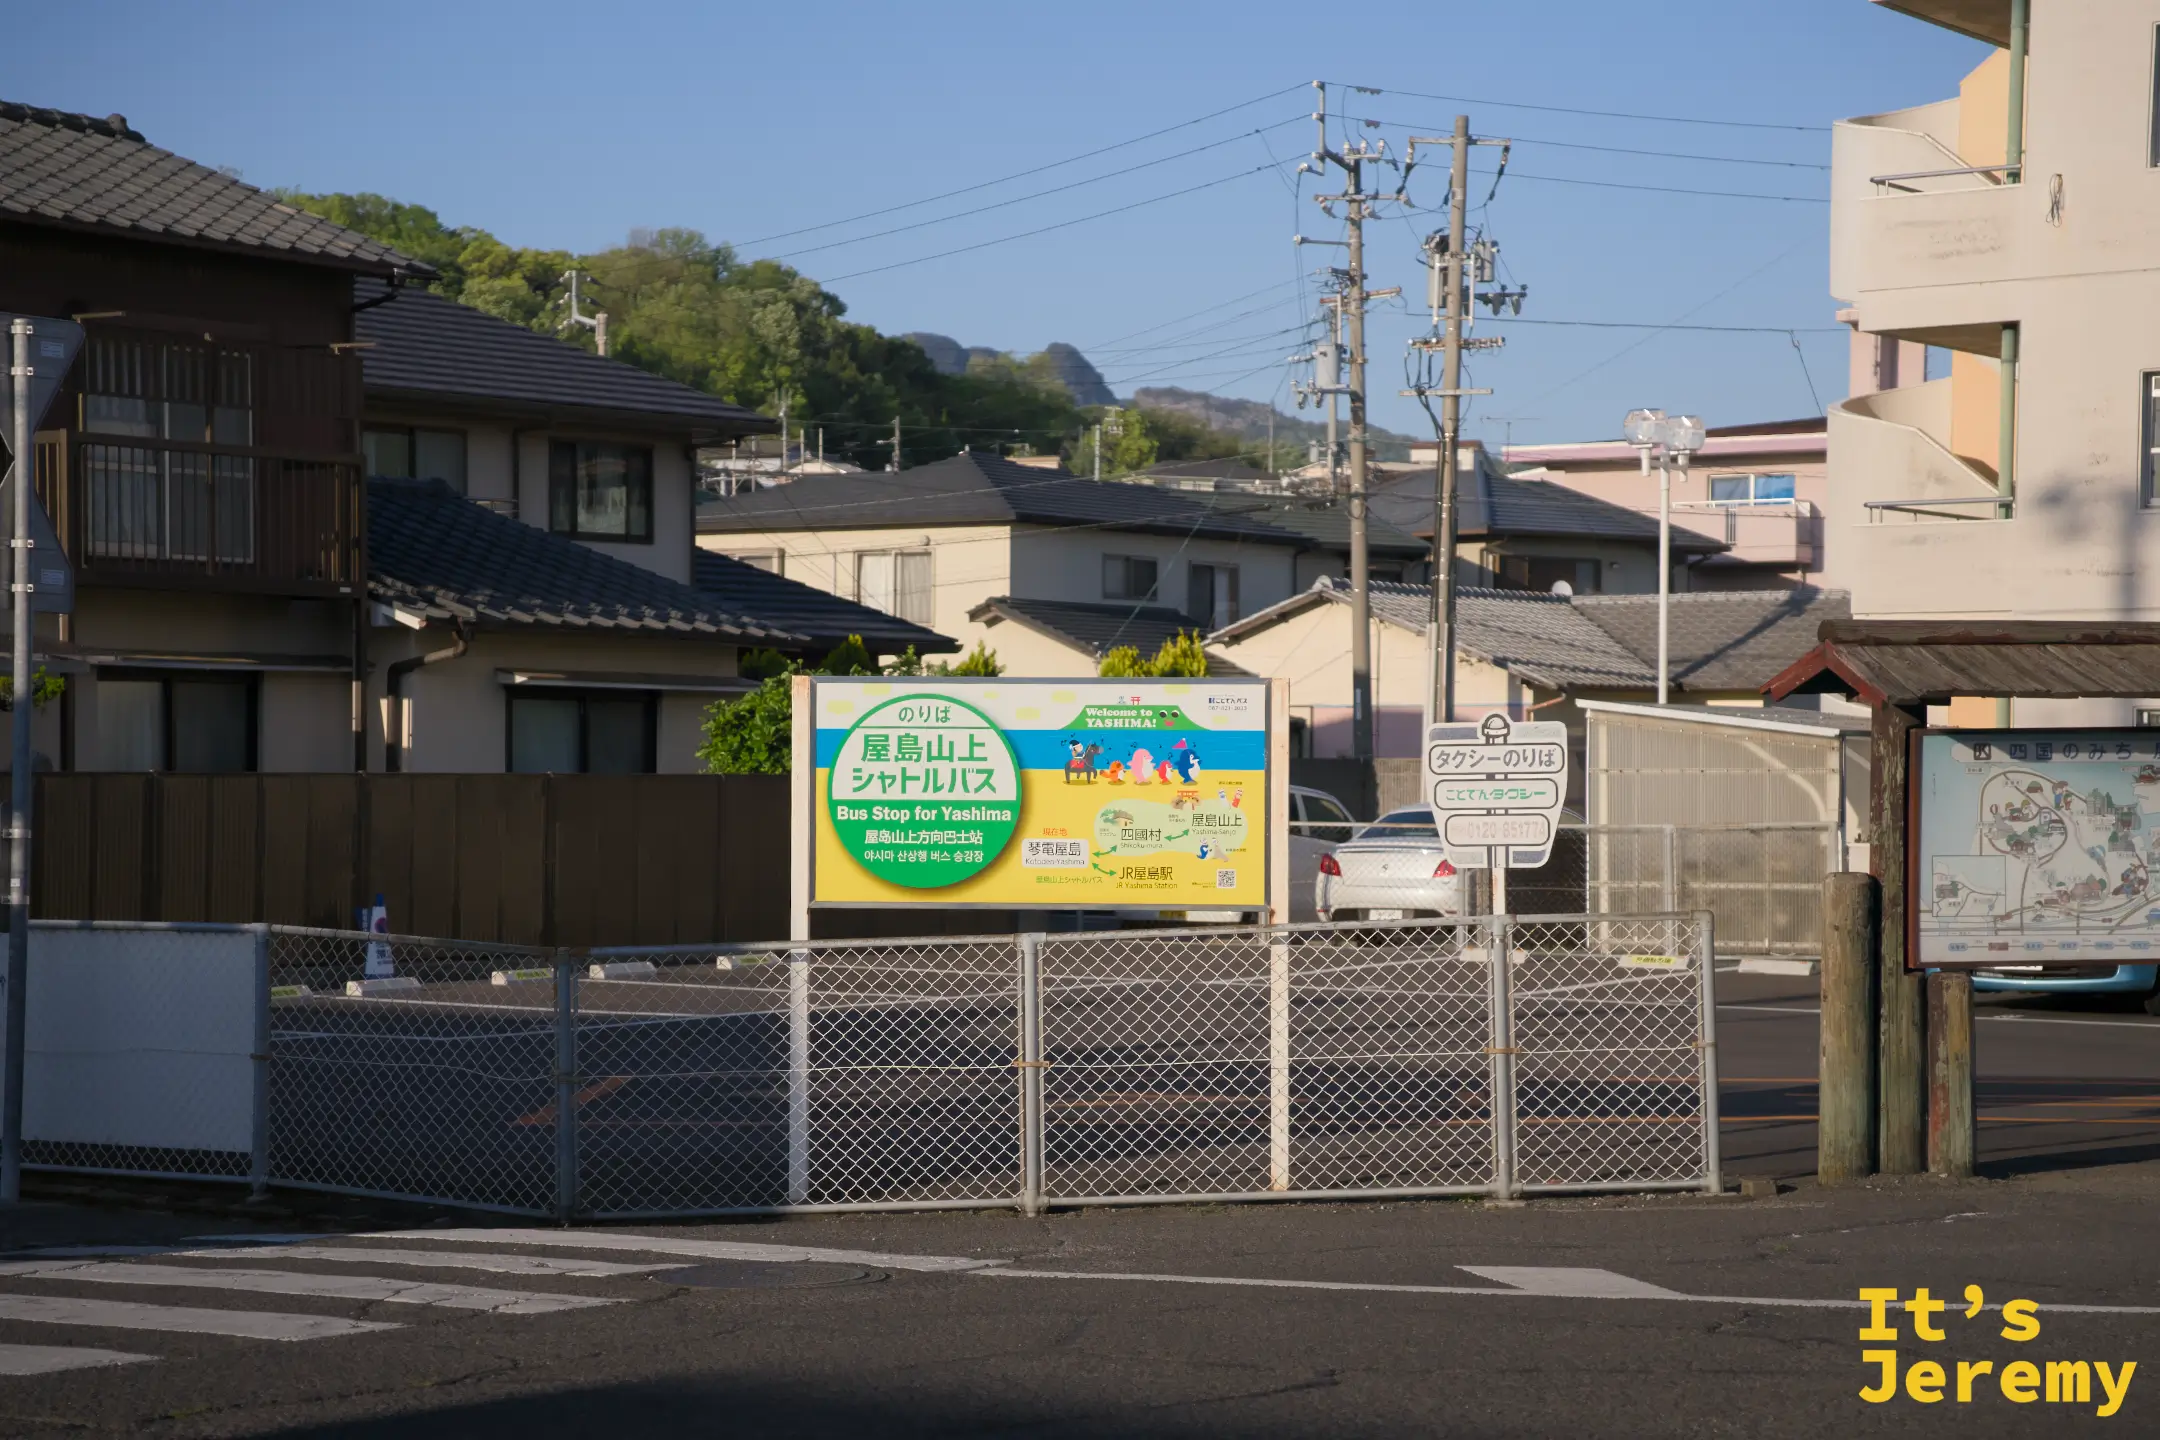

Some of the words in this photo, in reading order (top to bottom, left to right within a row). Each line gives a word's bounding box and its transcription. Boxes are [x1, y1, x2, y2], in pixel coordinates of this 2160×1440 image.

[898, 705, 951, 723] のりば
[1085, 707, 1136, 717] Welcome
[1140, 708, 1153, 717] to
[1085, 718, 1157, 728] YASHIMA!
[861, 733, 988, 762] 屋島山上
[1436, 748, 1557, 769] タクシーのりば
[852, 767, 997, 794] シャトルバス
[1446, 788, 1547, 801] ことでんタクシー
[837, 806, 868, 820] Bus
[872, 806, 910, 823] Stop
[915, 806, 938, 820] for
[942, 806, 1011, 821] Yashima
[1191, 813, 1243, 828] 屋島山上
[864, 829, 983, 845] 屋岛山上方向巴士站
[1043, 828, 1068, 836] 現在地
[1121, 828, 1162, 841] 四國村
[864, 850, 894, 862] 야시마
[897, 850, 928, 862] 산상행
[931, 850, 951, 862] 버스
[953, 850, 984, 862] 승강장
[1028, 842, 1081, 856] 琴電屋島
[1119, 867, 1173, 881] JR屋島駅
